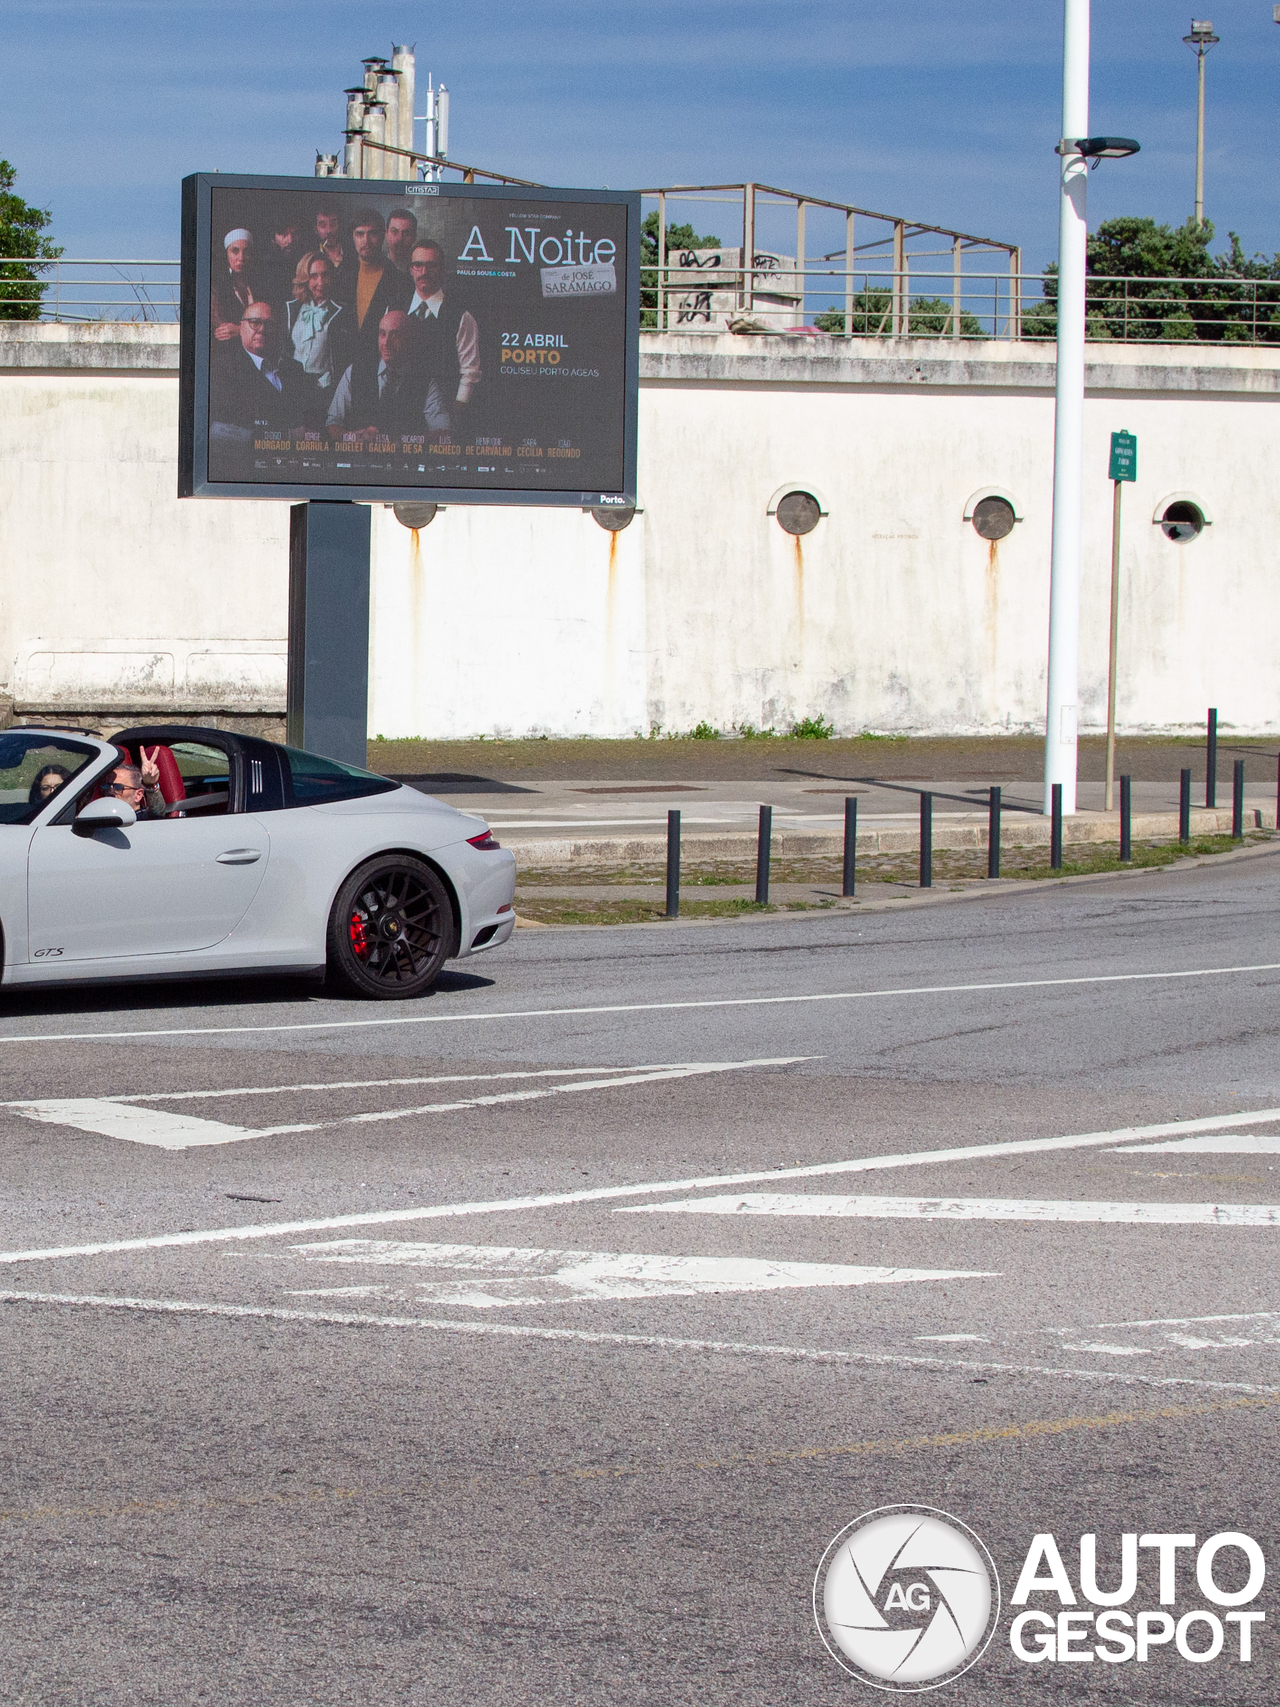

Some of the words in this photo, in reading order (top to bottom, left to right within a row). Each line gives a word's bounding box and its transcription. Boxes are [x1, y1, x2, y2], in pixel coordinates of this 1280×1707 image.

[458, 225, 494, 262] A
[505, 226, 616, 265] Noite
[572, 270, 594, 282] JOSÉ
[545, 280, 612, 294] SARAMAGO
[501, 332, 520, 346] 22
[524, 334, 568, 348] ABRIL
[501, 348, 560, 364] PORTO
[500, 366, 538, 375] COLISEU
[540, 367, 569, 376] PORTO
[571, 368, 600, 378] AGEAS
[254, 440, 291, 450] MORGADO
[296, 441, 329, 452] CORRULA
[402, 444, 412, 454] DE
[429, 444, 461, 455] PACHECO
[466, 446, 474, 456] DE
[476, 446, 512, 456] CARVALHO
[548, 448, 581, 458] REDONDO
[600, 494, 626, 504] Porto.
[34, 947, 64, 958] GTS
